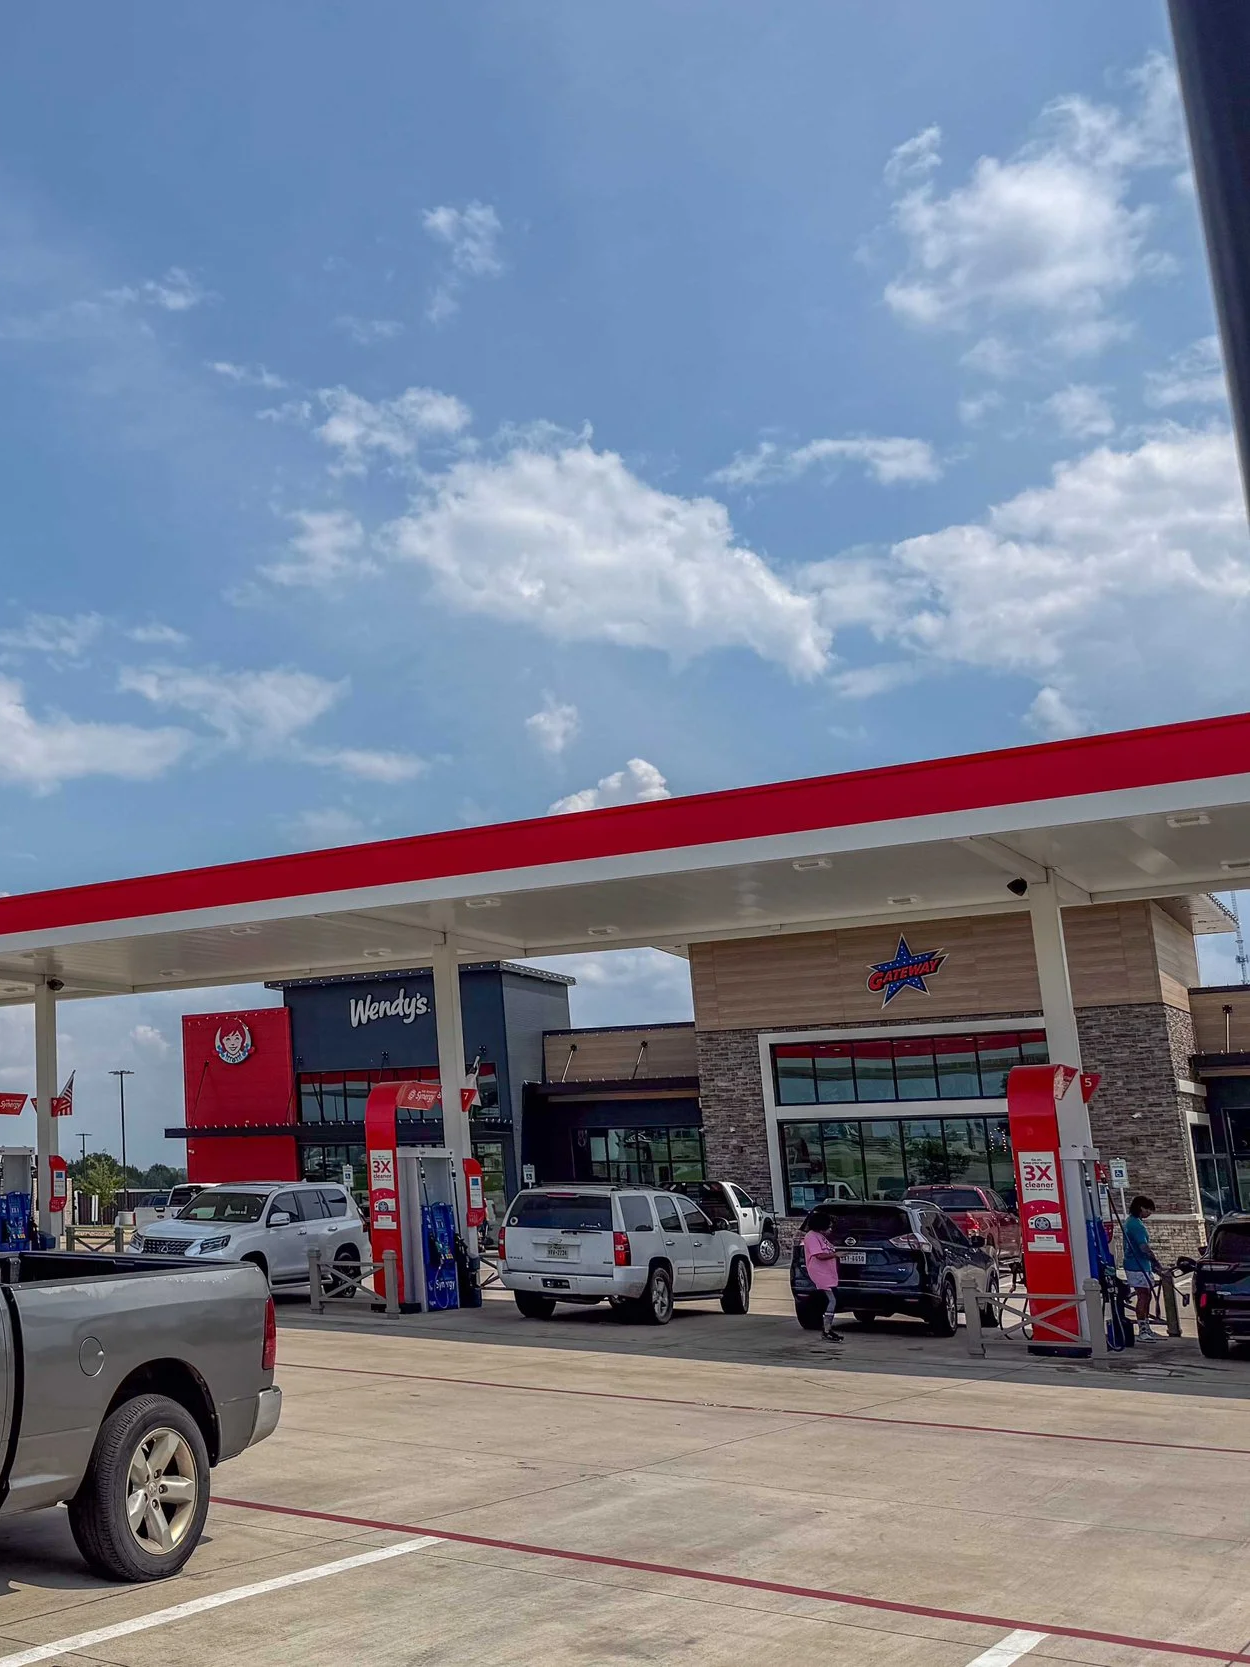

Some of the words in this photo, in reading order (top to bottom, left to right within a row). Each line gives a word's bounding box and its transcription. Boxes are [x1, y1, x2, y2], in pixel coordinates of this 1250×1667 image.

[867, 959, 940, 992] GATEWAY
[349, 987, 429, 1028] Wendy's
[1084, 1077, 1092, 1087] 5
[416, 1090, 436, 1103] Synergy
[463, 1092, 469, 1100] 7
[0, 1101, 22, 1110] Synergy
[372, 1160, 392, 1174] 3X
[1023, 1164, 1053, 1182] 3X
[1024, 1181, 1054, 1189] cleaner
